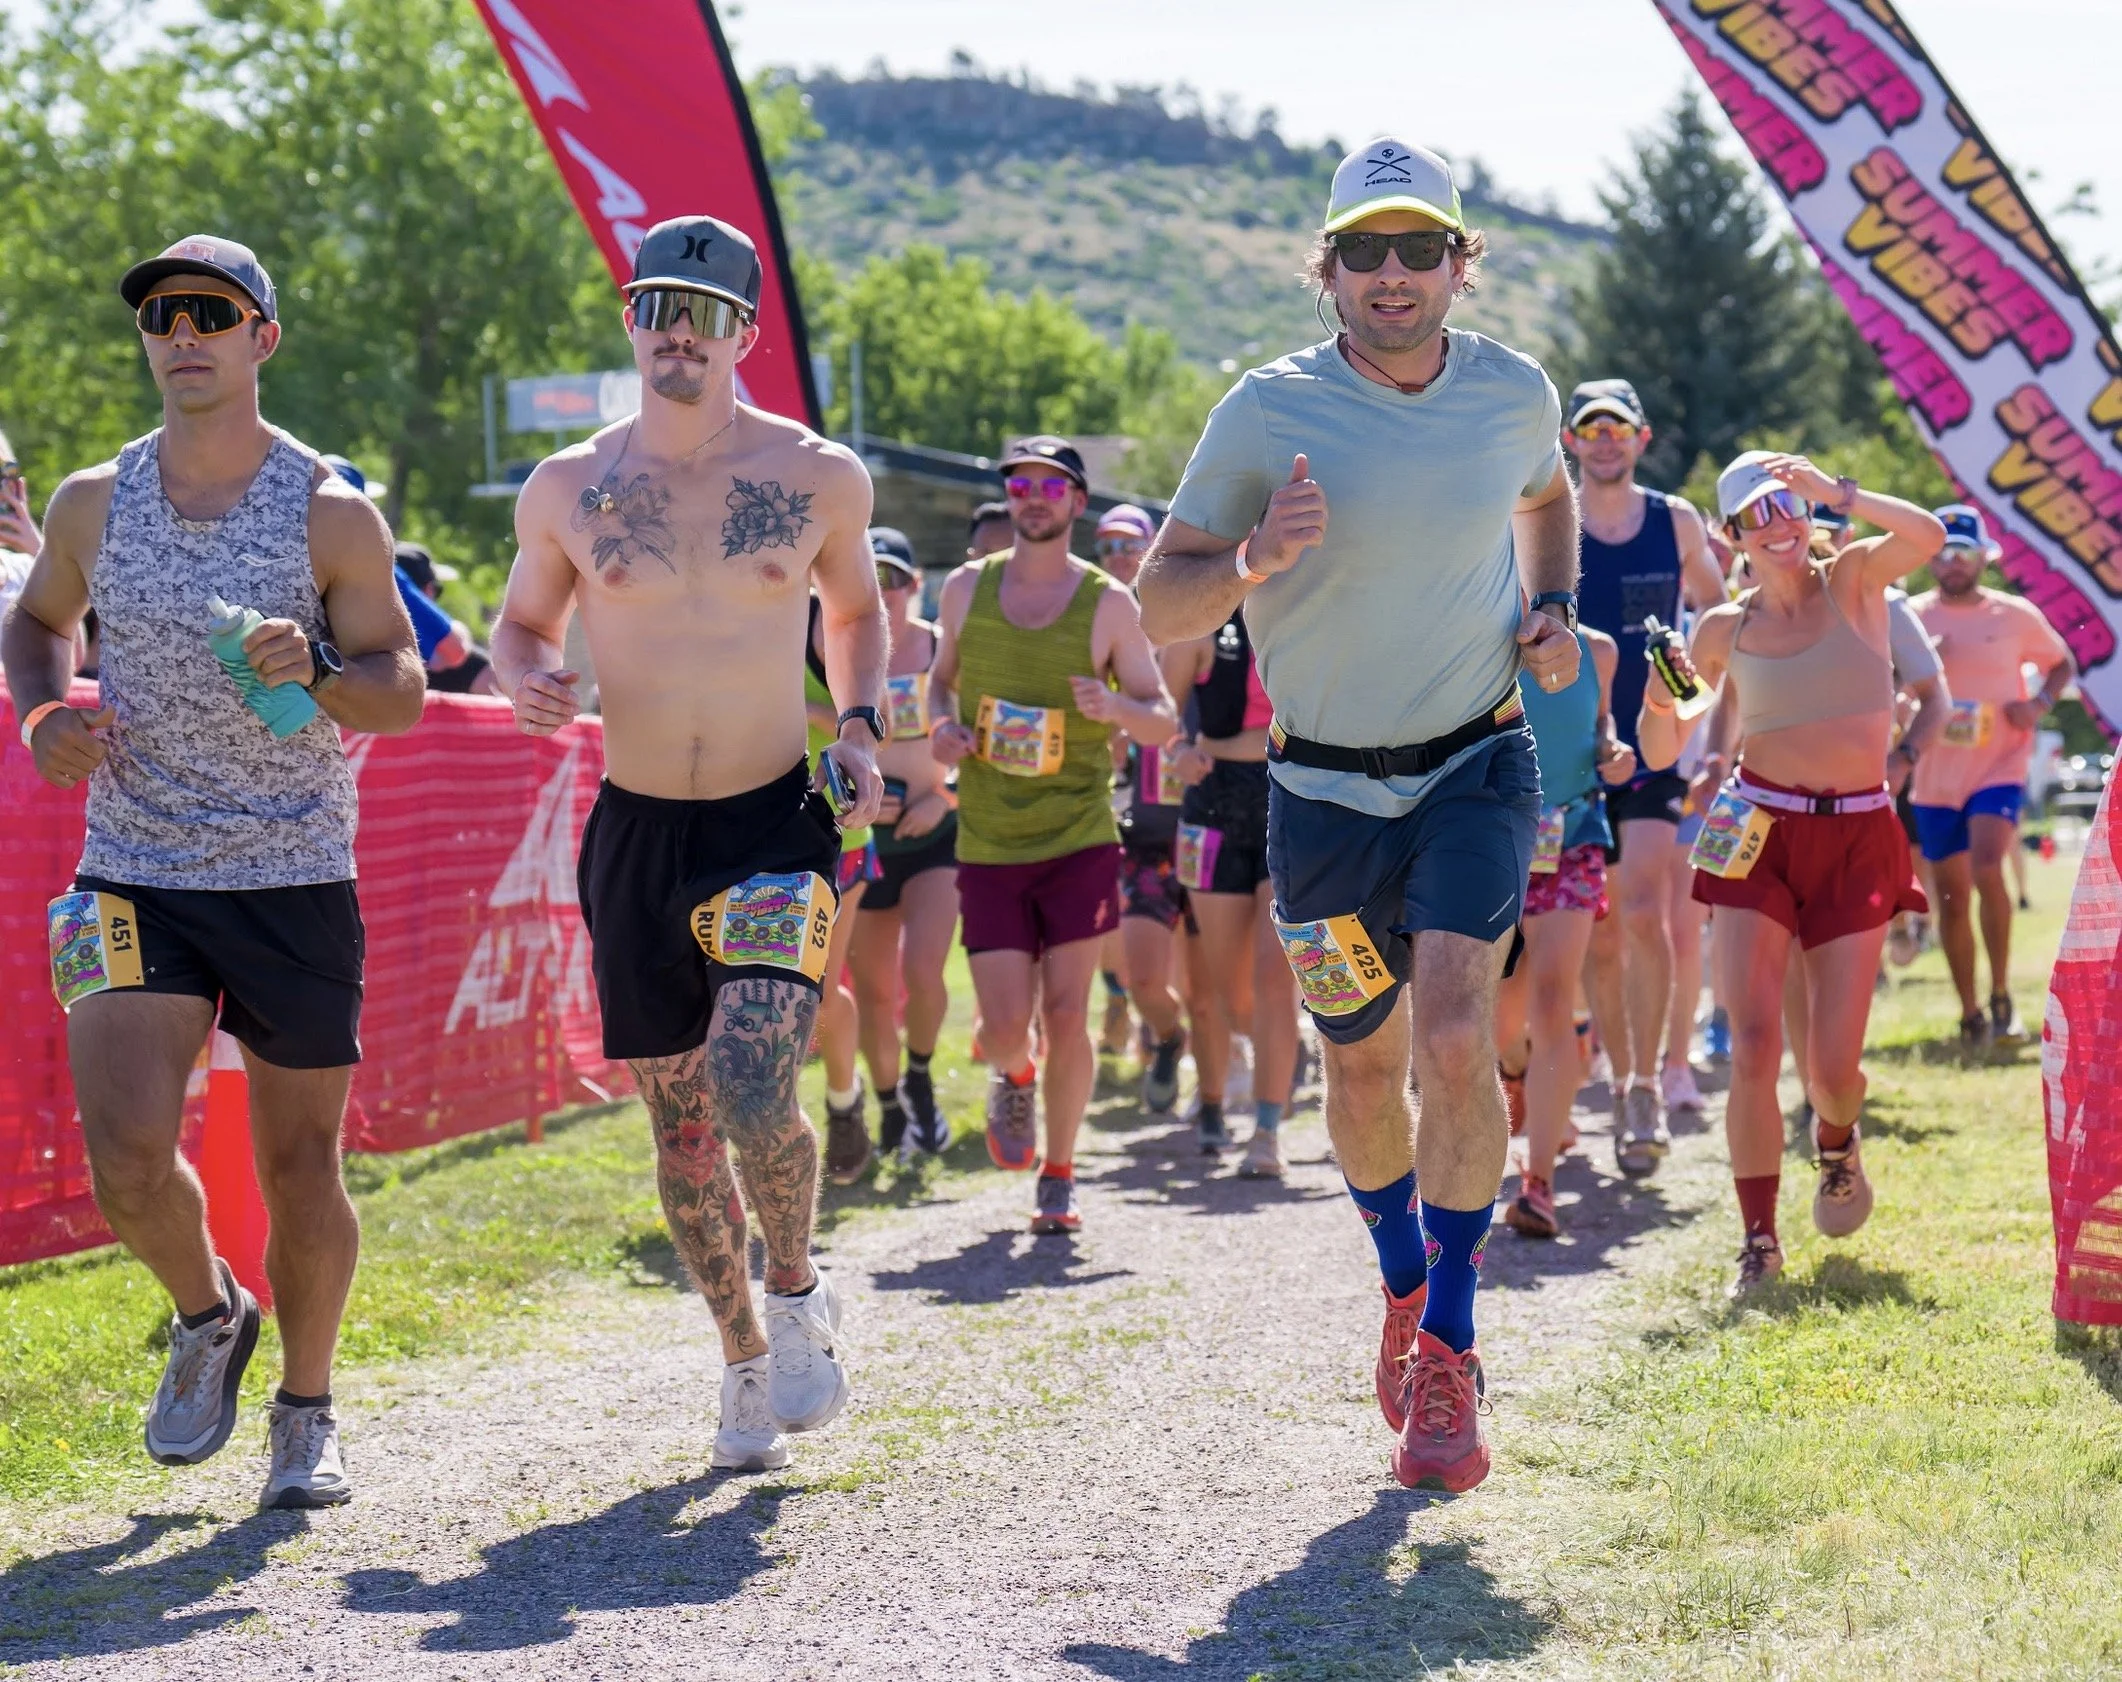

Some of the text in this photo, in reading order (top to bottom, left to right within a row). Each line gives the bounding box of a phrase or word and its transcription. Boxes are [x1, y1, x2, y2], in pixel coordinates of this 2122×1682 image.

[1657, 0, 1827, 197] MMER
[1768, 0, 1924, 134] MMER
[1364, 177, 1412, 187] HEAD
[1942, 138, 2072, 291] VIB
[1800, 222, 1971, 434] MMER
[1844, 203, 2003, 358] VIBES
[1851, 146, 2074, 370] SUMMER
[1934, 451, 2115, 674] MMER
[110, 916, 133, 951] 451
[697, 911, 715, 955] RUN
[811, 906, 828, 950] 452
[1351, 943, 1382, 980] 425
